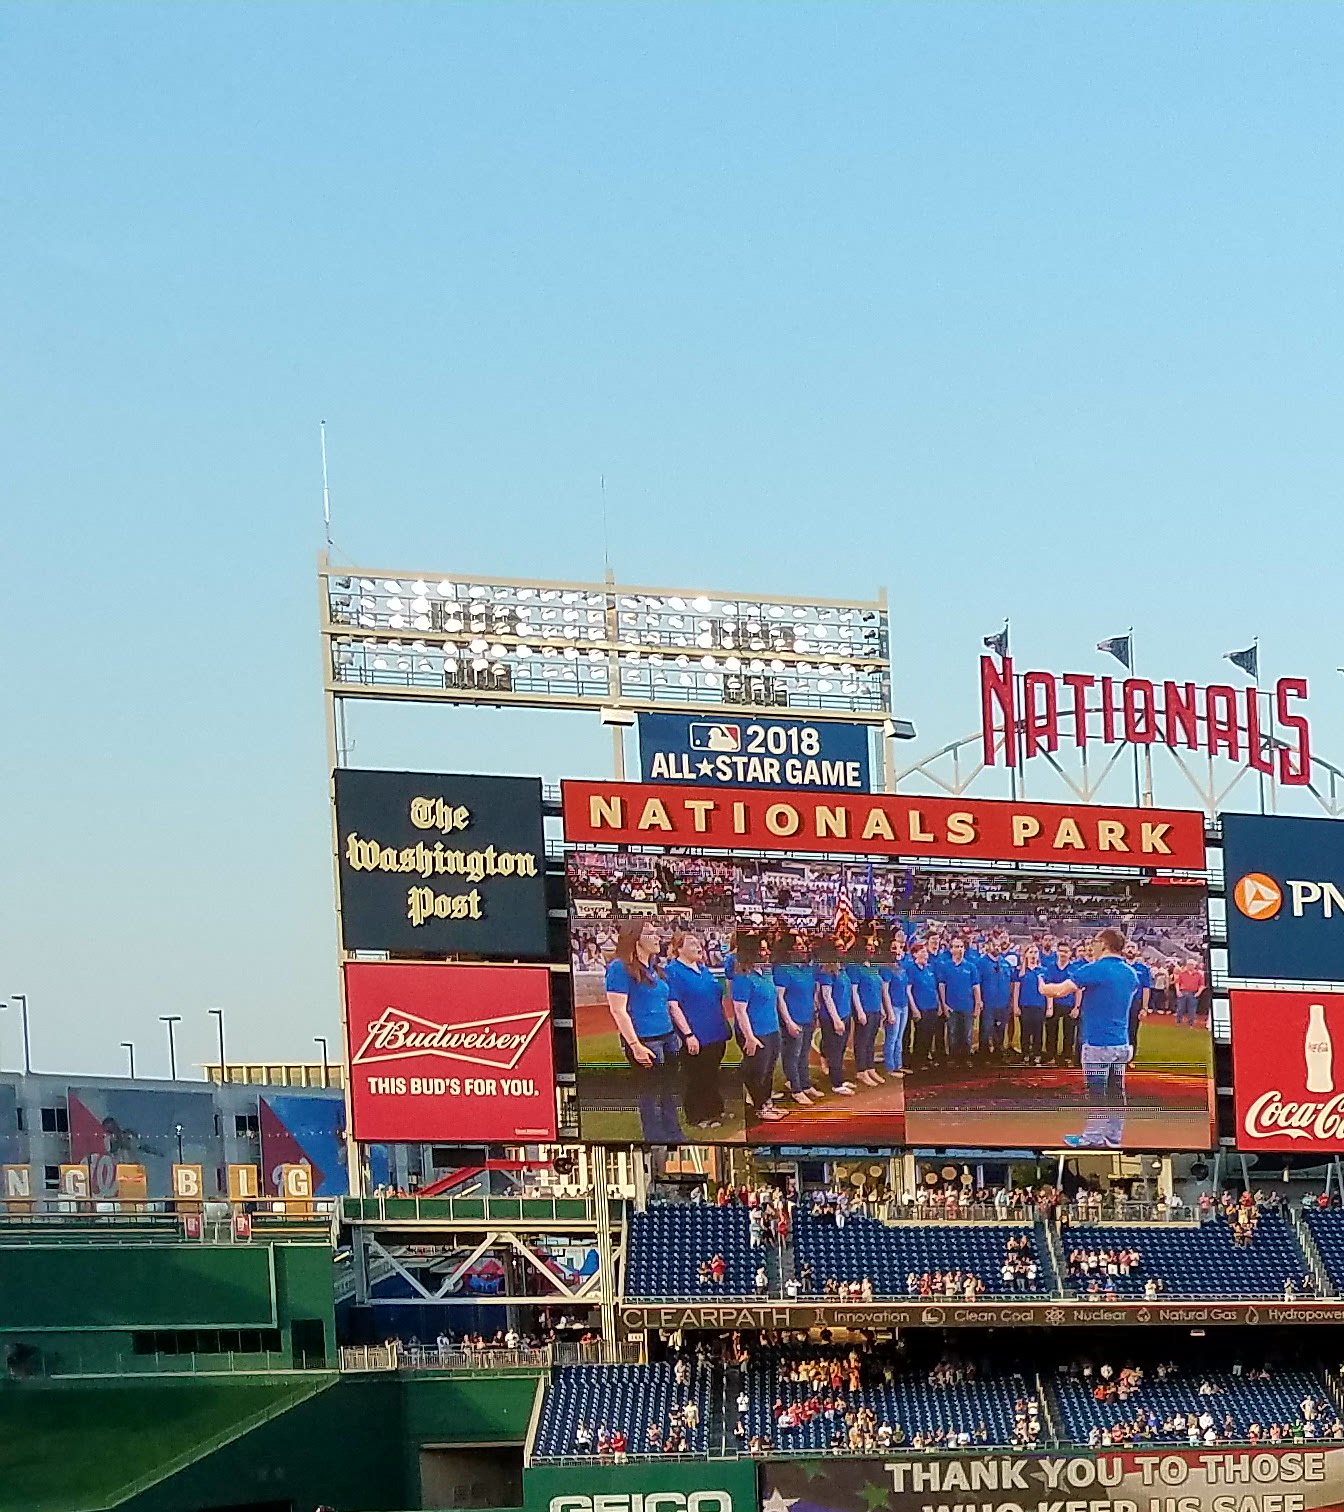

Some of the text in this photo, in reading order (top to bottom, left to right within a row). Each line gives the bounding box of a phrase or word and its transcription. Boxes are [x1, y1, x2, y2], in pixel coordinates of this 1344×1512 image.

[980, 656, 1311, 785] NATIONALS
[747, 724, 820, 756] 2018
[785, 759, 862, 787] GAME
[410, 797, 469, 834] The
[589, 795, 1174, 856] NATIONALS PARK
[345, 832, 538, 882] Washington
[407, 886, 482, 926] Post
[368, 1019, 530, 1051] Budweiser
[368, 1077, 539, 1097] THIS BUD'S FOR YOU.
[623, 1308, 790, 1328] CLEARPATH
[833, 1310, 910, 1323] Innovation
[954, 1311, 997, 1323] Clean
[1000, 1311, 1034, 1323] Coal
[1073, 1310, 1127, 1322] Nuclear
[1159, 1308, 1207, 1321] Natural
[1209, 1308, 1238, 1321] Gas
[884, 1451, 1326, 1494] THANK YOU TO THOSE
